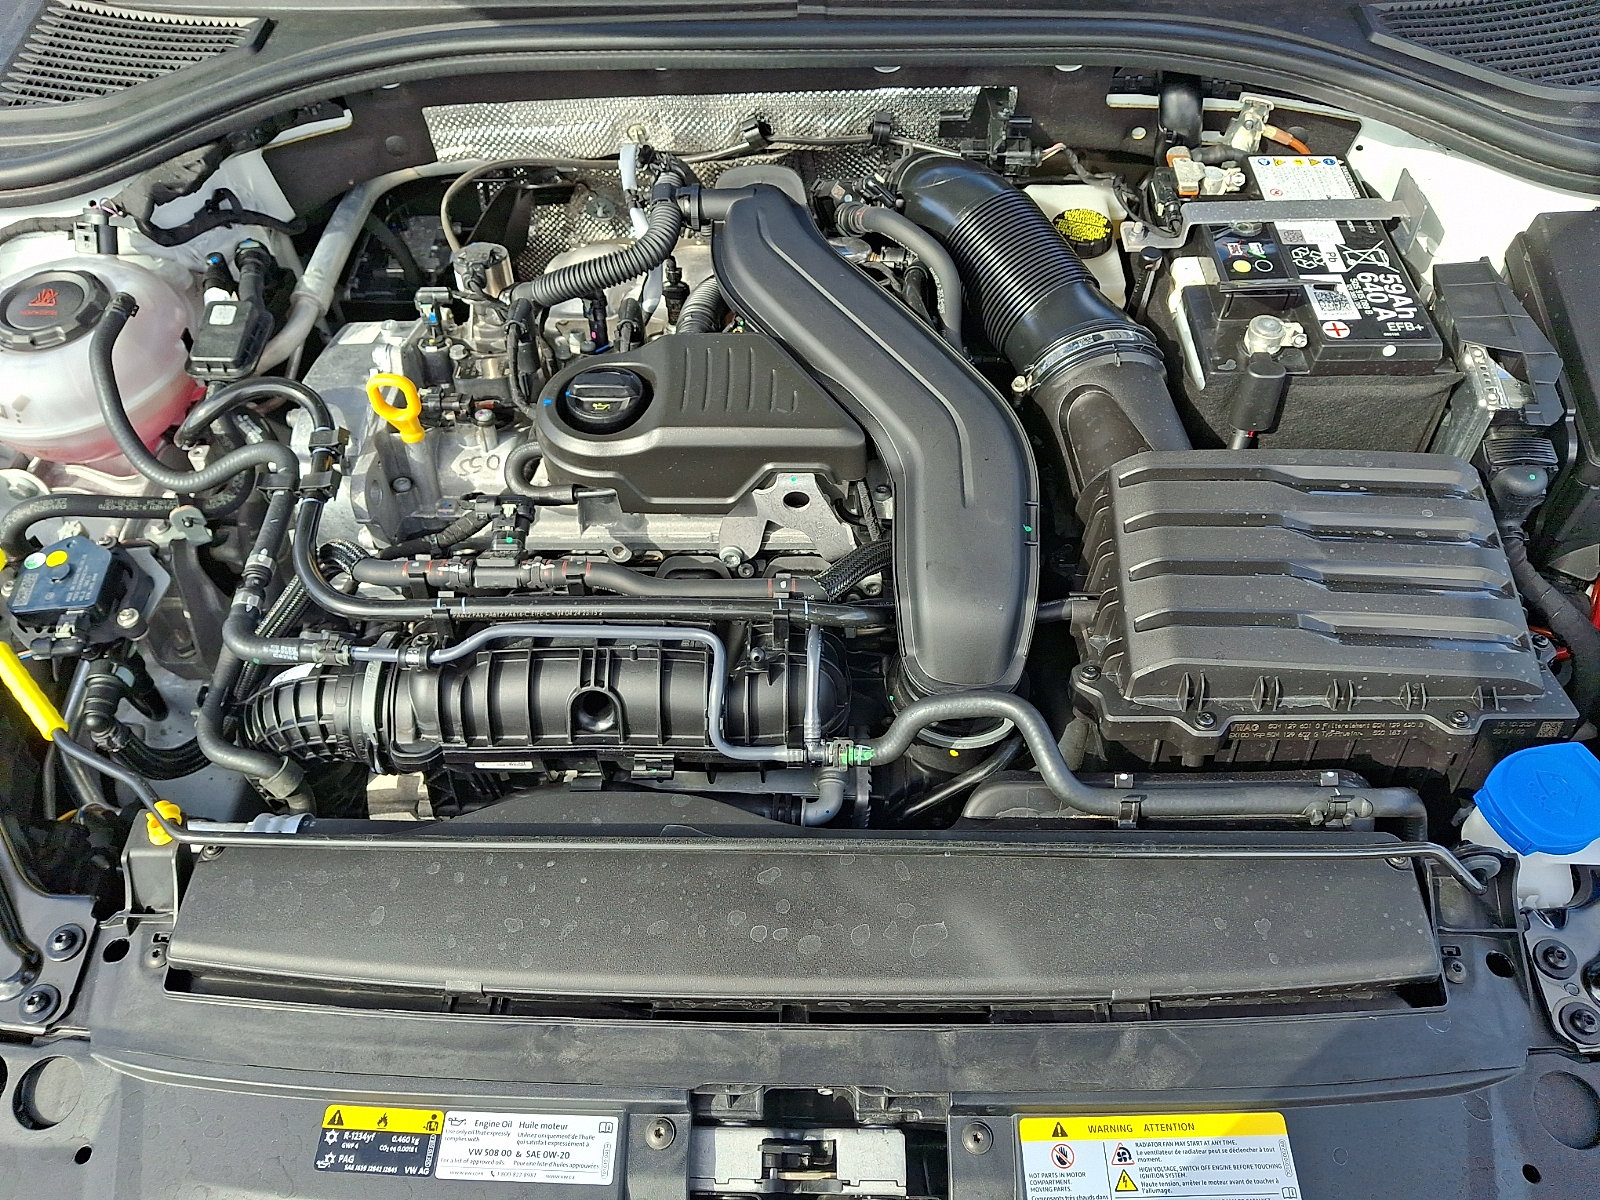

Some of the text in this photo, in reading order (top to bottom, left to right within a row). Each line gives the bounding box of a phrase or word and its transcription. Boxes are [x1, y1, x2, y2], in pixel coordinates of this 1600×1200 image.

[1326, 251, 1338, 263] Pb
[1357, 272, 1389, 303] 640
[1379, 274, 1417, 318] 59Ah
[1372, 307, 1397, 321] A
[1387, 322, 1424, 331] EFB+
[475, 1120, 500, 1129] Engine
[519, 1121, 538, 1129] Huile
[1088, 1124, 1133, 1133] WARNING
[1144, 1122, 1195, 1131] ATTENTION
[343, 1132, 377, 1143] R-1234yf
[411, 1136, 420, 1145] kg
[526, 1150, 541, 1158] SAE
[543, 1151, 570, 1159] 0W-20
[338, 1155, 354, 1164] PAG
